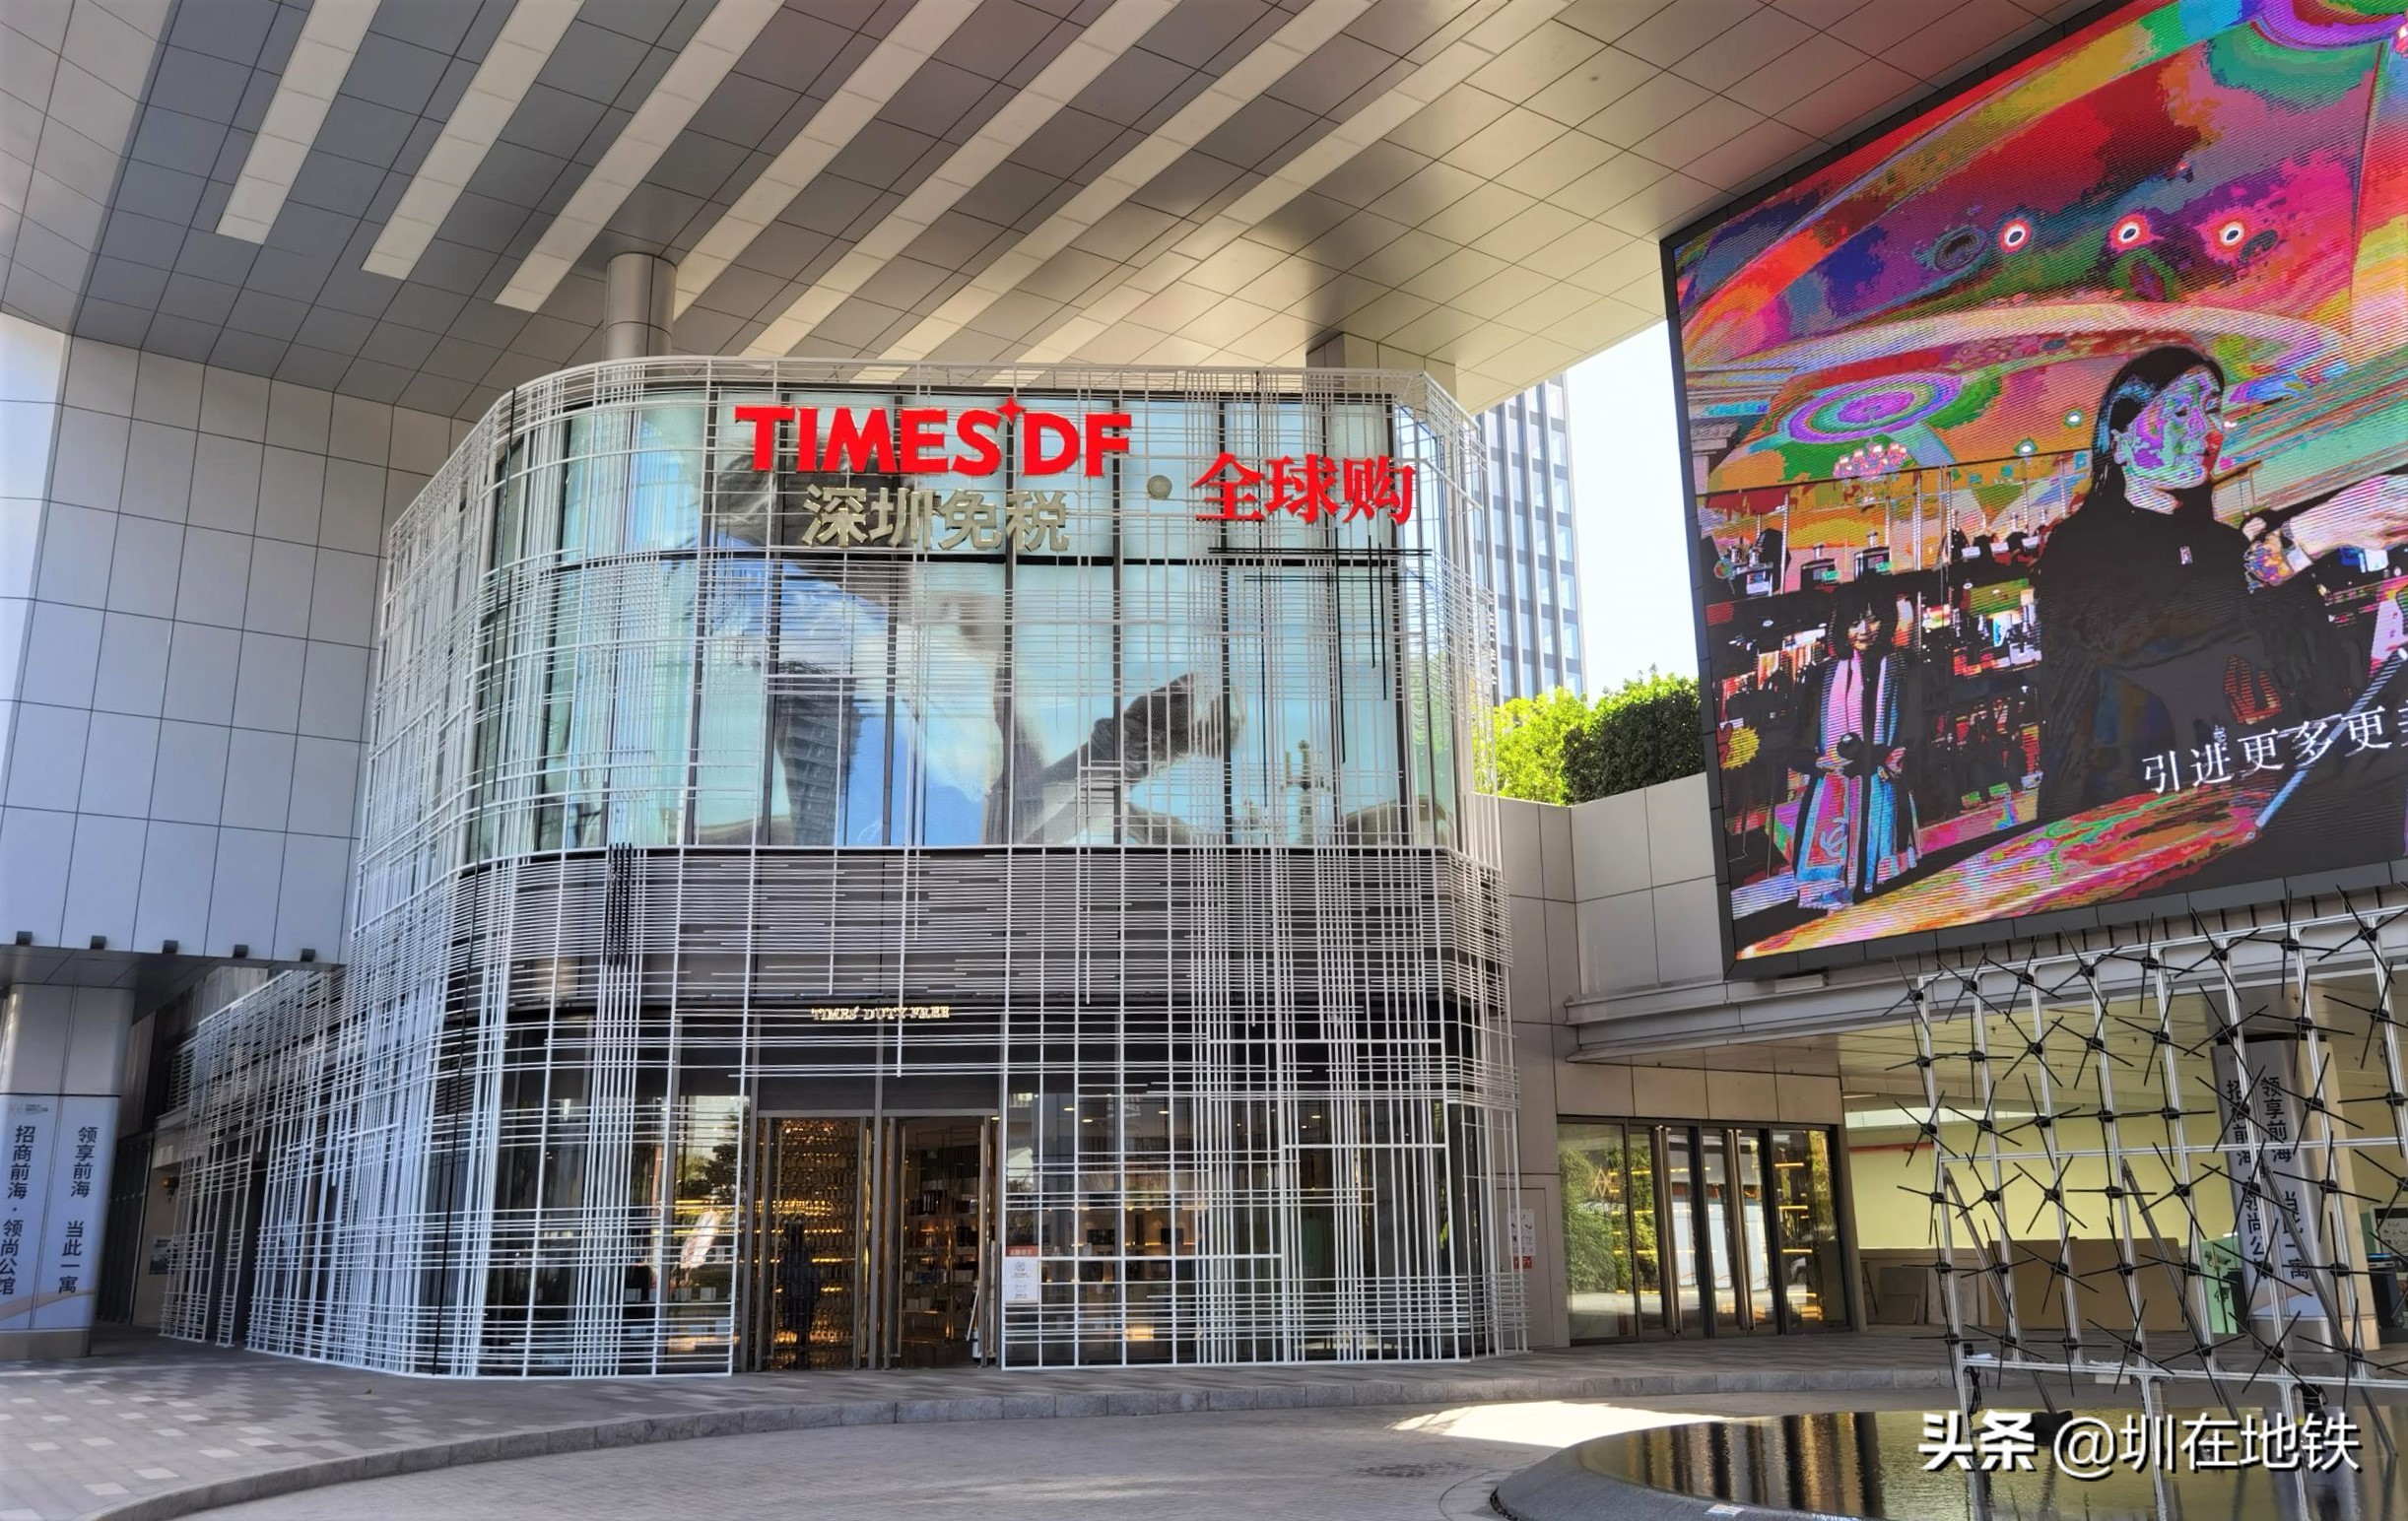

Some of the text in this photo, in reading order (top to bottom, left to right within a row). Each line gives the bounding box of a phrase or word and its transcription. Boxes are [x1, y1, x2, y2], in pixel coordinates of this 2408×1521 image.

[802, 484, 1071, 552] 深圳免税
[1193, 452, 1413, 525] 全球购
[2142, 699, 2408, 794] 引进更多更
[863, 1007, 907, 1021] DUTY
[910, 1006, 950, 1020] FREE
[58, 1126, 99, 1293] 领享前海 当此一寓
